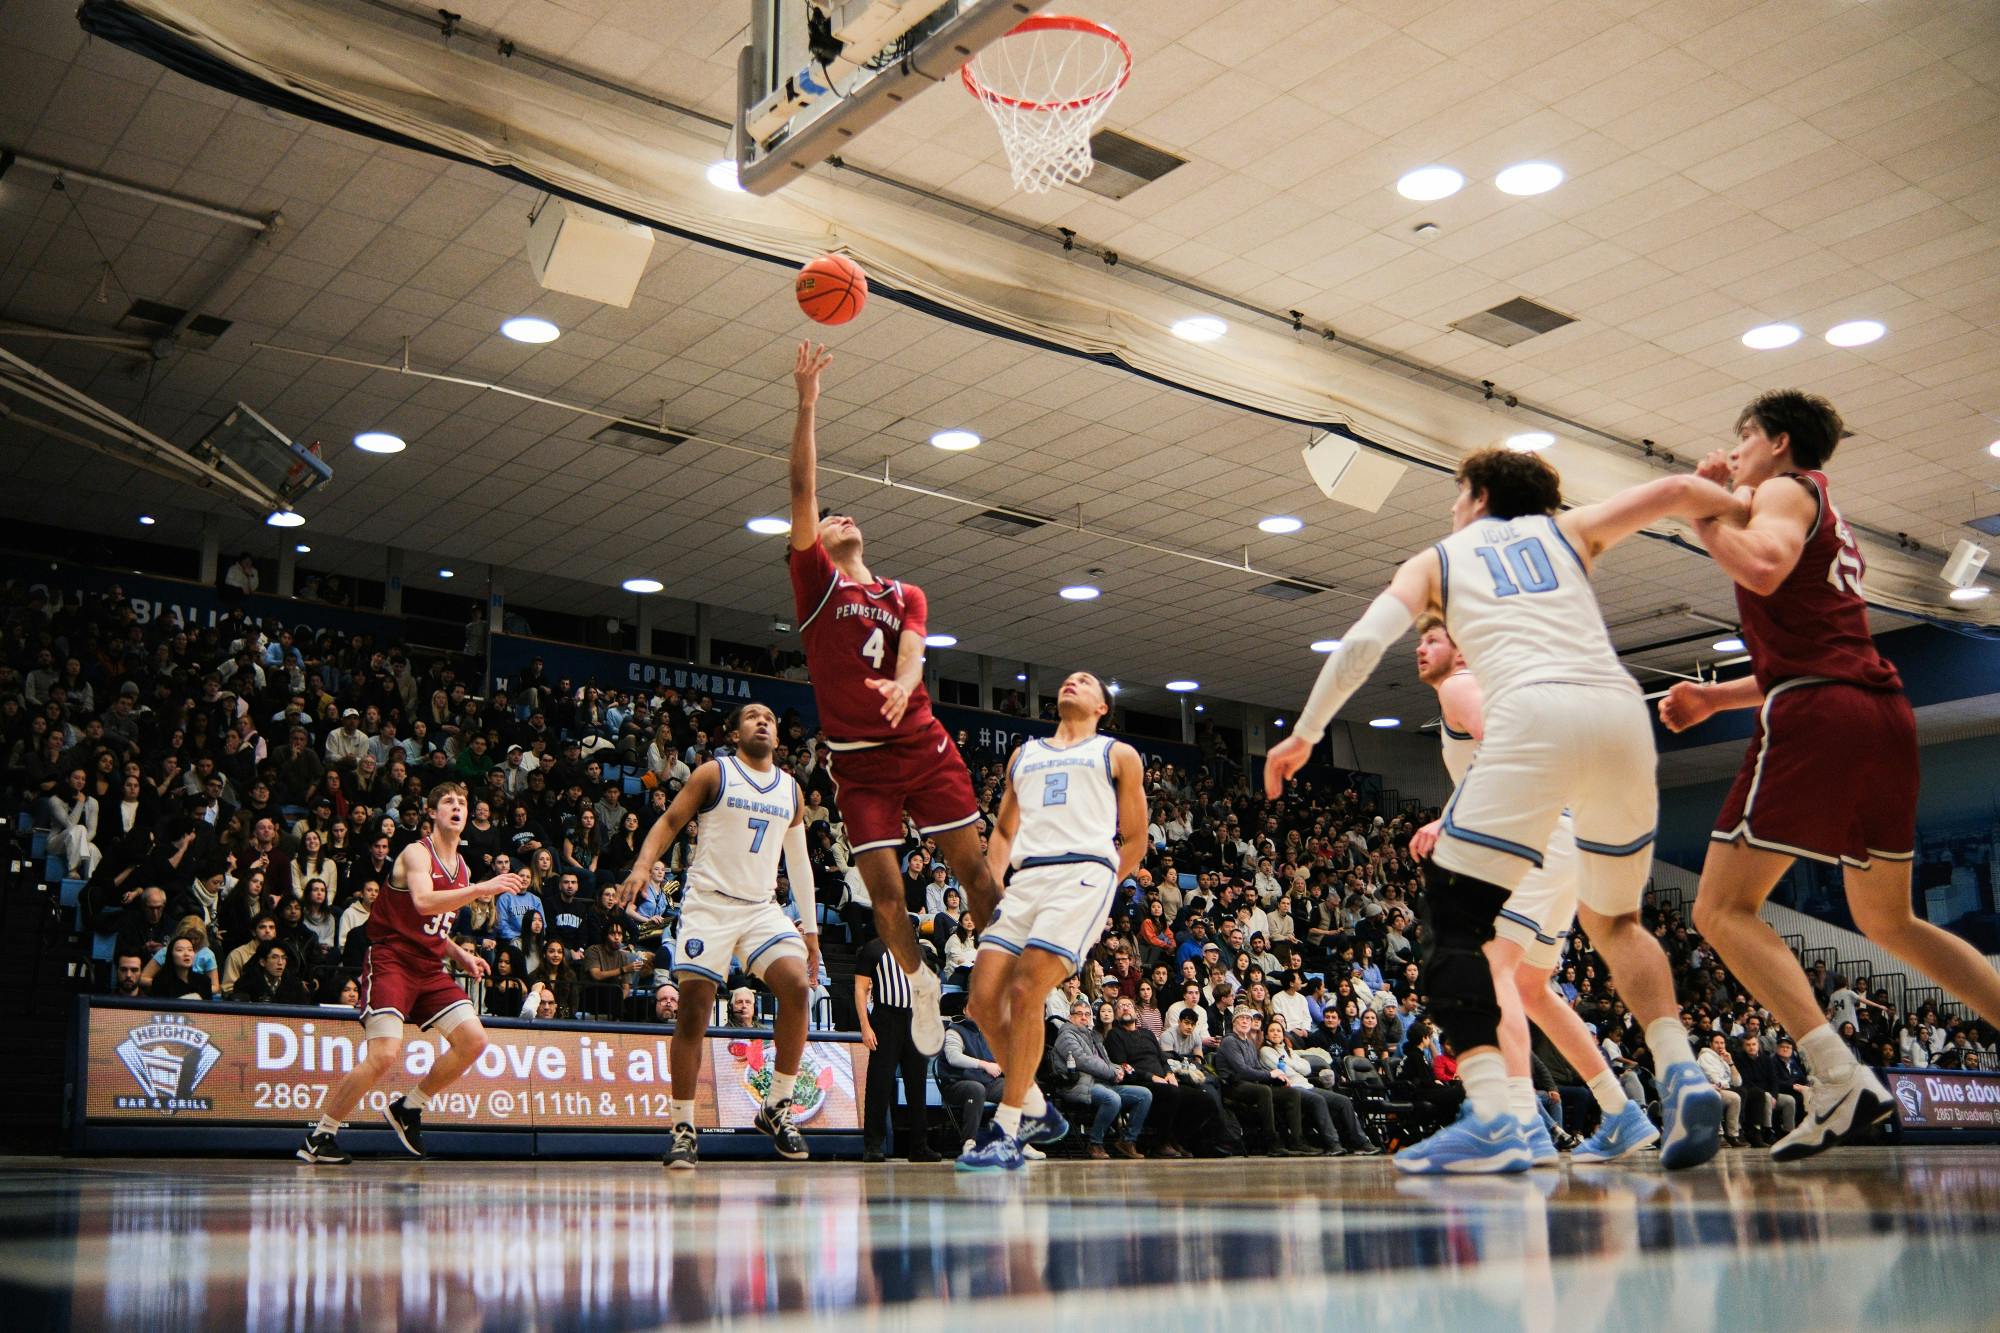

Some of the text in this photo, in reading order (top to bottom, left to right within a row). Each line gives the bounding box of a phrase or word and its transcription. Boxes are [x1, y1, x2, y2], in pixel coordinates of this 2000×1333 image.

[1473, 536, 1560, 598] 10
[862, 627, 885, 669] 4
[629, 662, 752, 698] COLUMBIA
[1042, 772, 1069, 807] 2
[727, 796, 790, 820] COLUMBIA
[748, 817, 770, 854] 7
[136, 1025, 205, 1045] HEIGHTS
[256, 1022, 368, 1073] Din
[579, 1036, 616, 1082] it
[118, 1097, 147, 1109] BAR
[168, 1098, 208, 1110] GRILL
[254, 1082, 329, 1110] 2867
[488, 1090, 592, 1118] @111th
[600, 1092, 617, 1116] &
[624, 1094, 673, 1117] 112
[1925, 1077, 1965, 1102] Dine
[1954, 1107, 1994, 1125] Broadway
